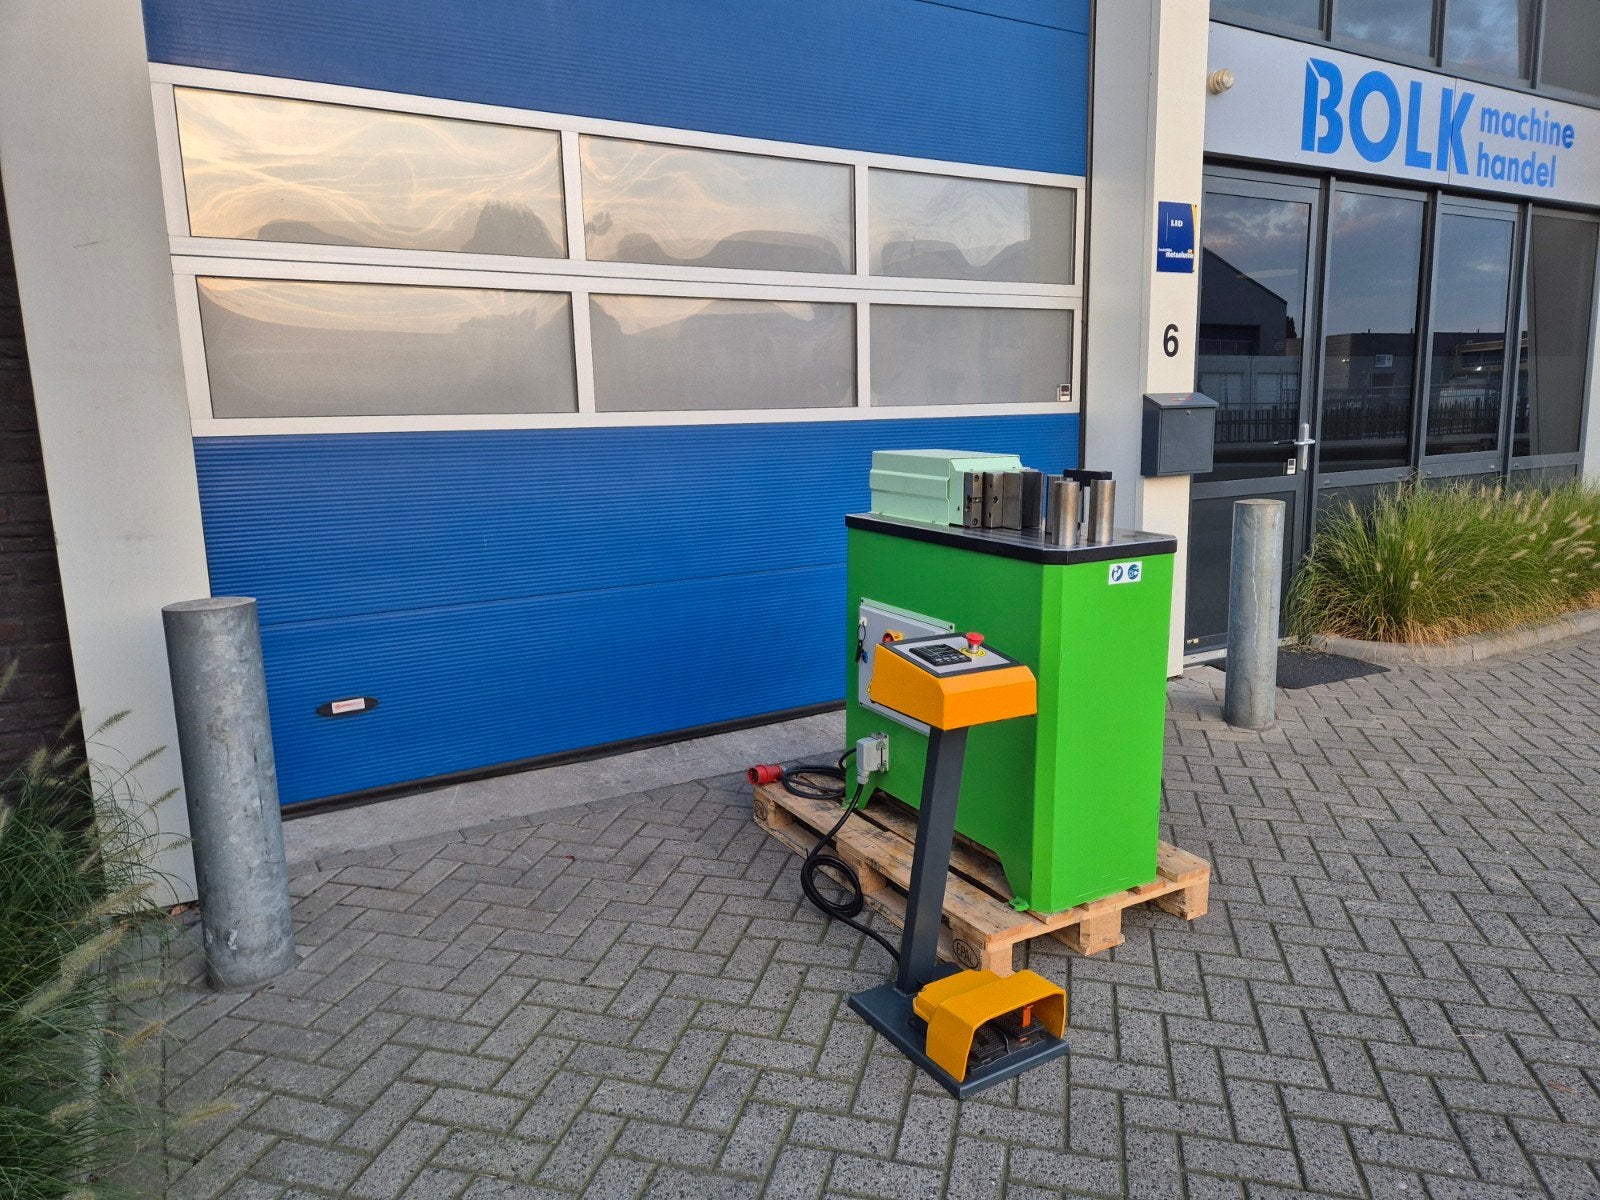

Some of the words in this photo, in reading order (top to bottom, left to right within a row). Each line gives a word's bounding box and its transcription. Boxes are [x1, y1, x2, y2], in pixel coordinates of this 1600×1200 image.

[1301, 57, 1476, 176] BOLK
[1480, 106, 1575, 149] machine
[1476, 141, 1557, 187] handel
[1163, 323, 1180, 358] 6
[956, 941, 976, 967] EPAL
